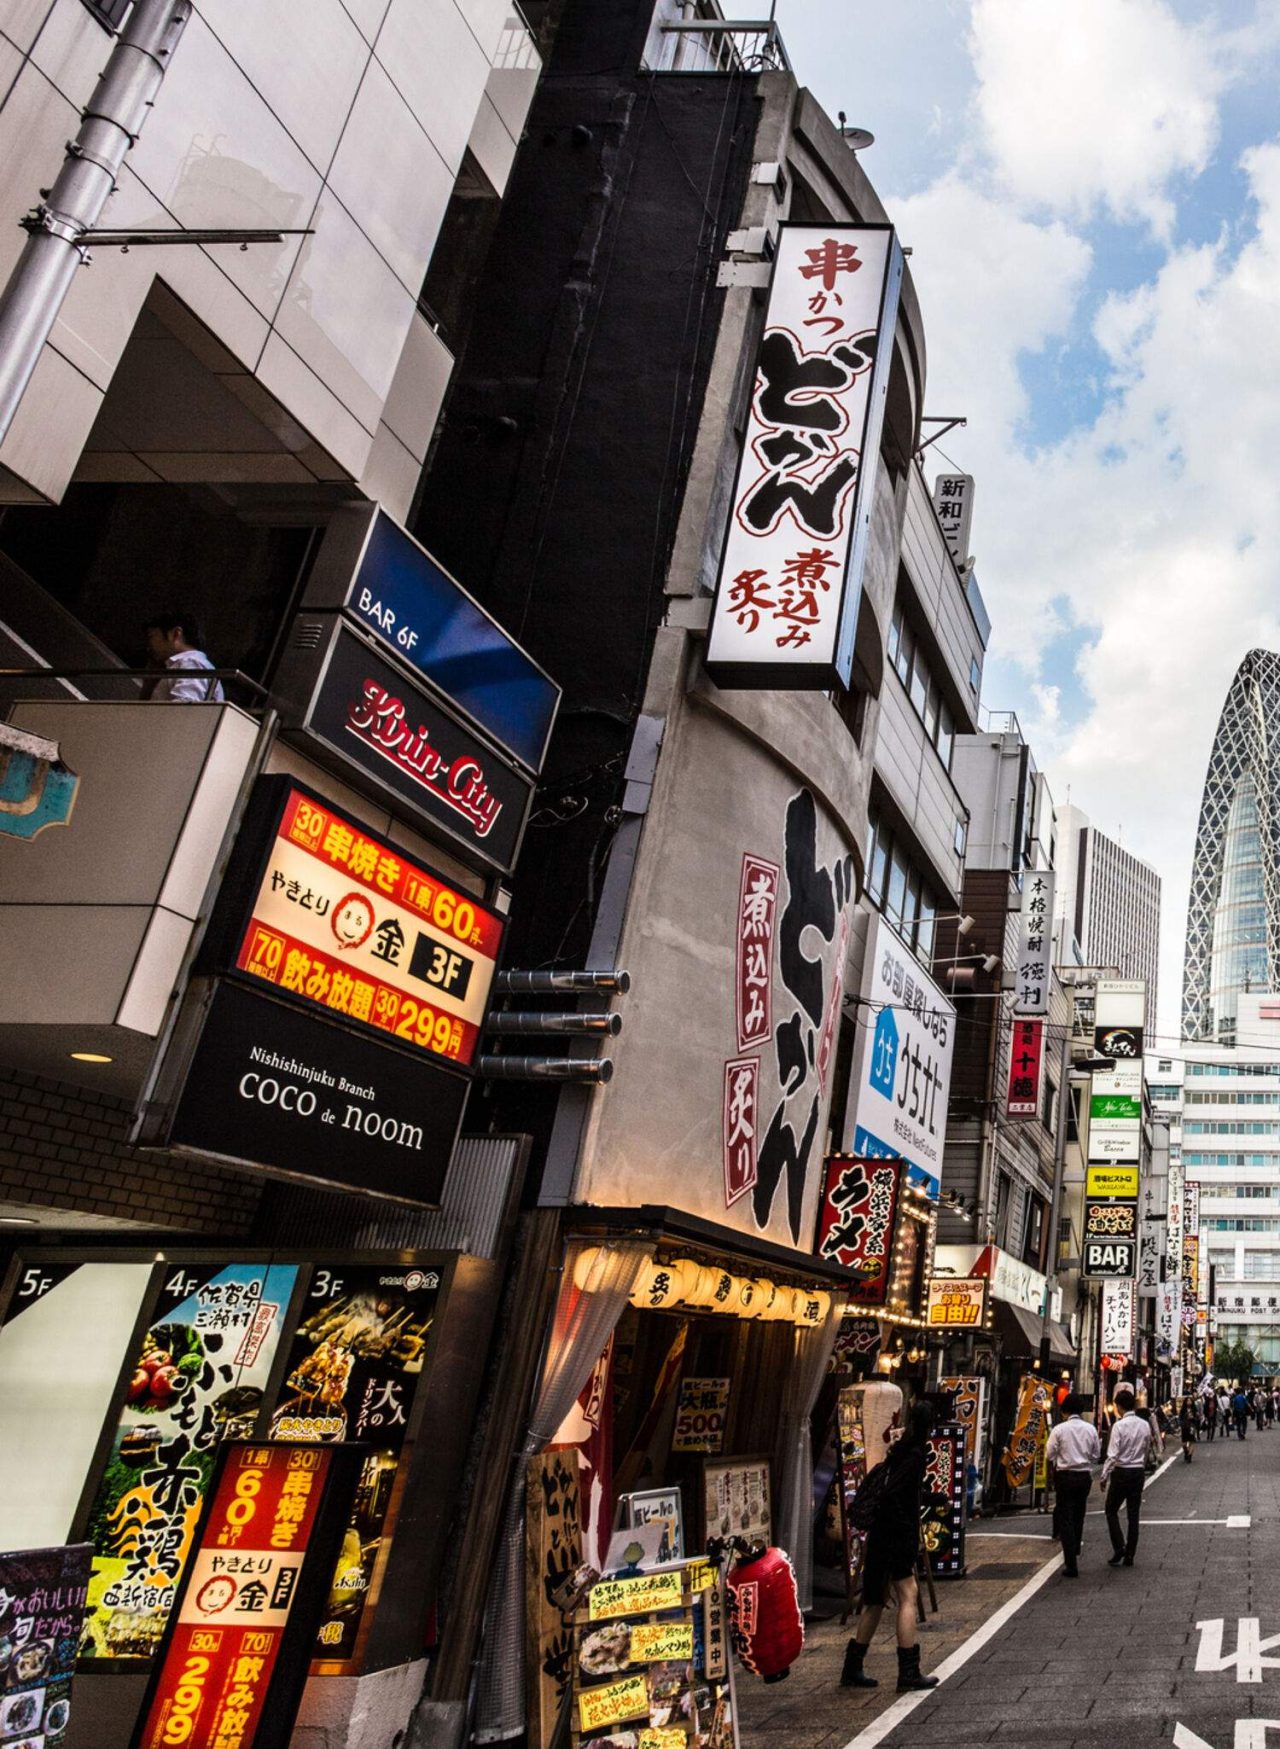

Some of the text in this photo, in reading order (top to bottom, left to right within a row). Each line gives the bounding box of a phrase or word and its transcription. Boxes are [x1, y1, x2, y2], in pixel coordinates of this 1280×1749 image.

[798, 238, 864, 336] 串かつ
[745, 331, 878, 535] どかん
[359, 587, 418, 650] BAR 6F
[727, 569, 776, 634] 炙り
[772, 548, 843, 650] 煮込み
[348, 677, 503, 837] Kirin-City
[295, 804, 324, 838] 30
[323, 823, 400, 893] 串焼き
[271, 870, 330, 917] やきとり
[407, 879, 433, 912] 1串
[432, 891, 475, 938] 60
[1028, 879, 1049, 951] 本格焼酎
[255, 933, 282, 969] 70
[371, 917, 405, 967] 金
[742, 874, 775, 1034] 煮込み
[279, 949, 376, 1023] 飲み放題
[426, 946, 462, 988] 3F
[1019, 964, 1046, 1006] 徳利
[752, 788, 853, 1245] どかん
[881, 950, 948, 1049] お部屋探しなら
[394, 1000, 451, 1053] 299
[1104, 1040, 1136, 1056] まんてん
[249, 1046, 376, 1101] Nishishinjuku Branch
[1014, 1052, 1036, 1097] 十徳
[238, 1072, 425, 1151] coco de noom
[729, 1069, 754, 1181] 炙り
[1094, 1175, 1132, 1183] 酒場ビストロ
[864, 1169, 895, 1256] 横浜家系
[1089, 1246, 1129, 1266] BAR
[18, 1269, 53, 1296] 5F
[165, 1270, 198, 1297] 4F
[199, 1281, 261, 1308] 佐賀県
[311, 1271, 344, 1297] 3F
[1117, 1280, 1130, 1329] 肉あんかけ
[195, 1310, 252, 1331] 三瀬村
[930, 1304, 978, 1324] 自由!!
[1104, 1295, 1116, 1344] チャーハン
[356, 1378, 376, 1436] ドリンクバー
[678, 1414, 722, 1435] 500
[246, 1450, 267, 1465] 1串
[290, 1451, 314, 1468] 30
[226, 1470, 265, 1525] 60
[270, 1471, 313, 1548] 串焼き
[211, 1556, 274, 1574] やきとり
[274, 1569, 291, 1605] 3F
[335, 1577, 367, 1590] Asahi
[104, 1584, 174, 1607] 西新宿店
[234, 1579, 268, 1612] 金
[162, 1656, 211, 1746] 299
